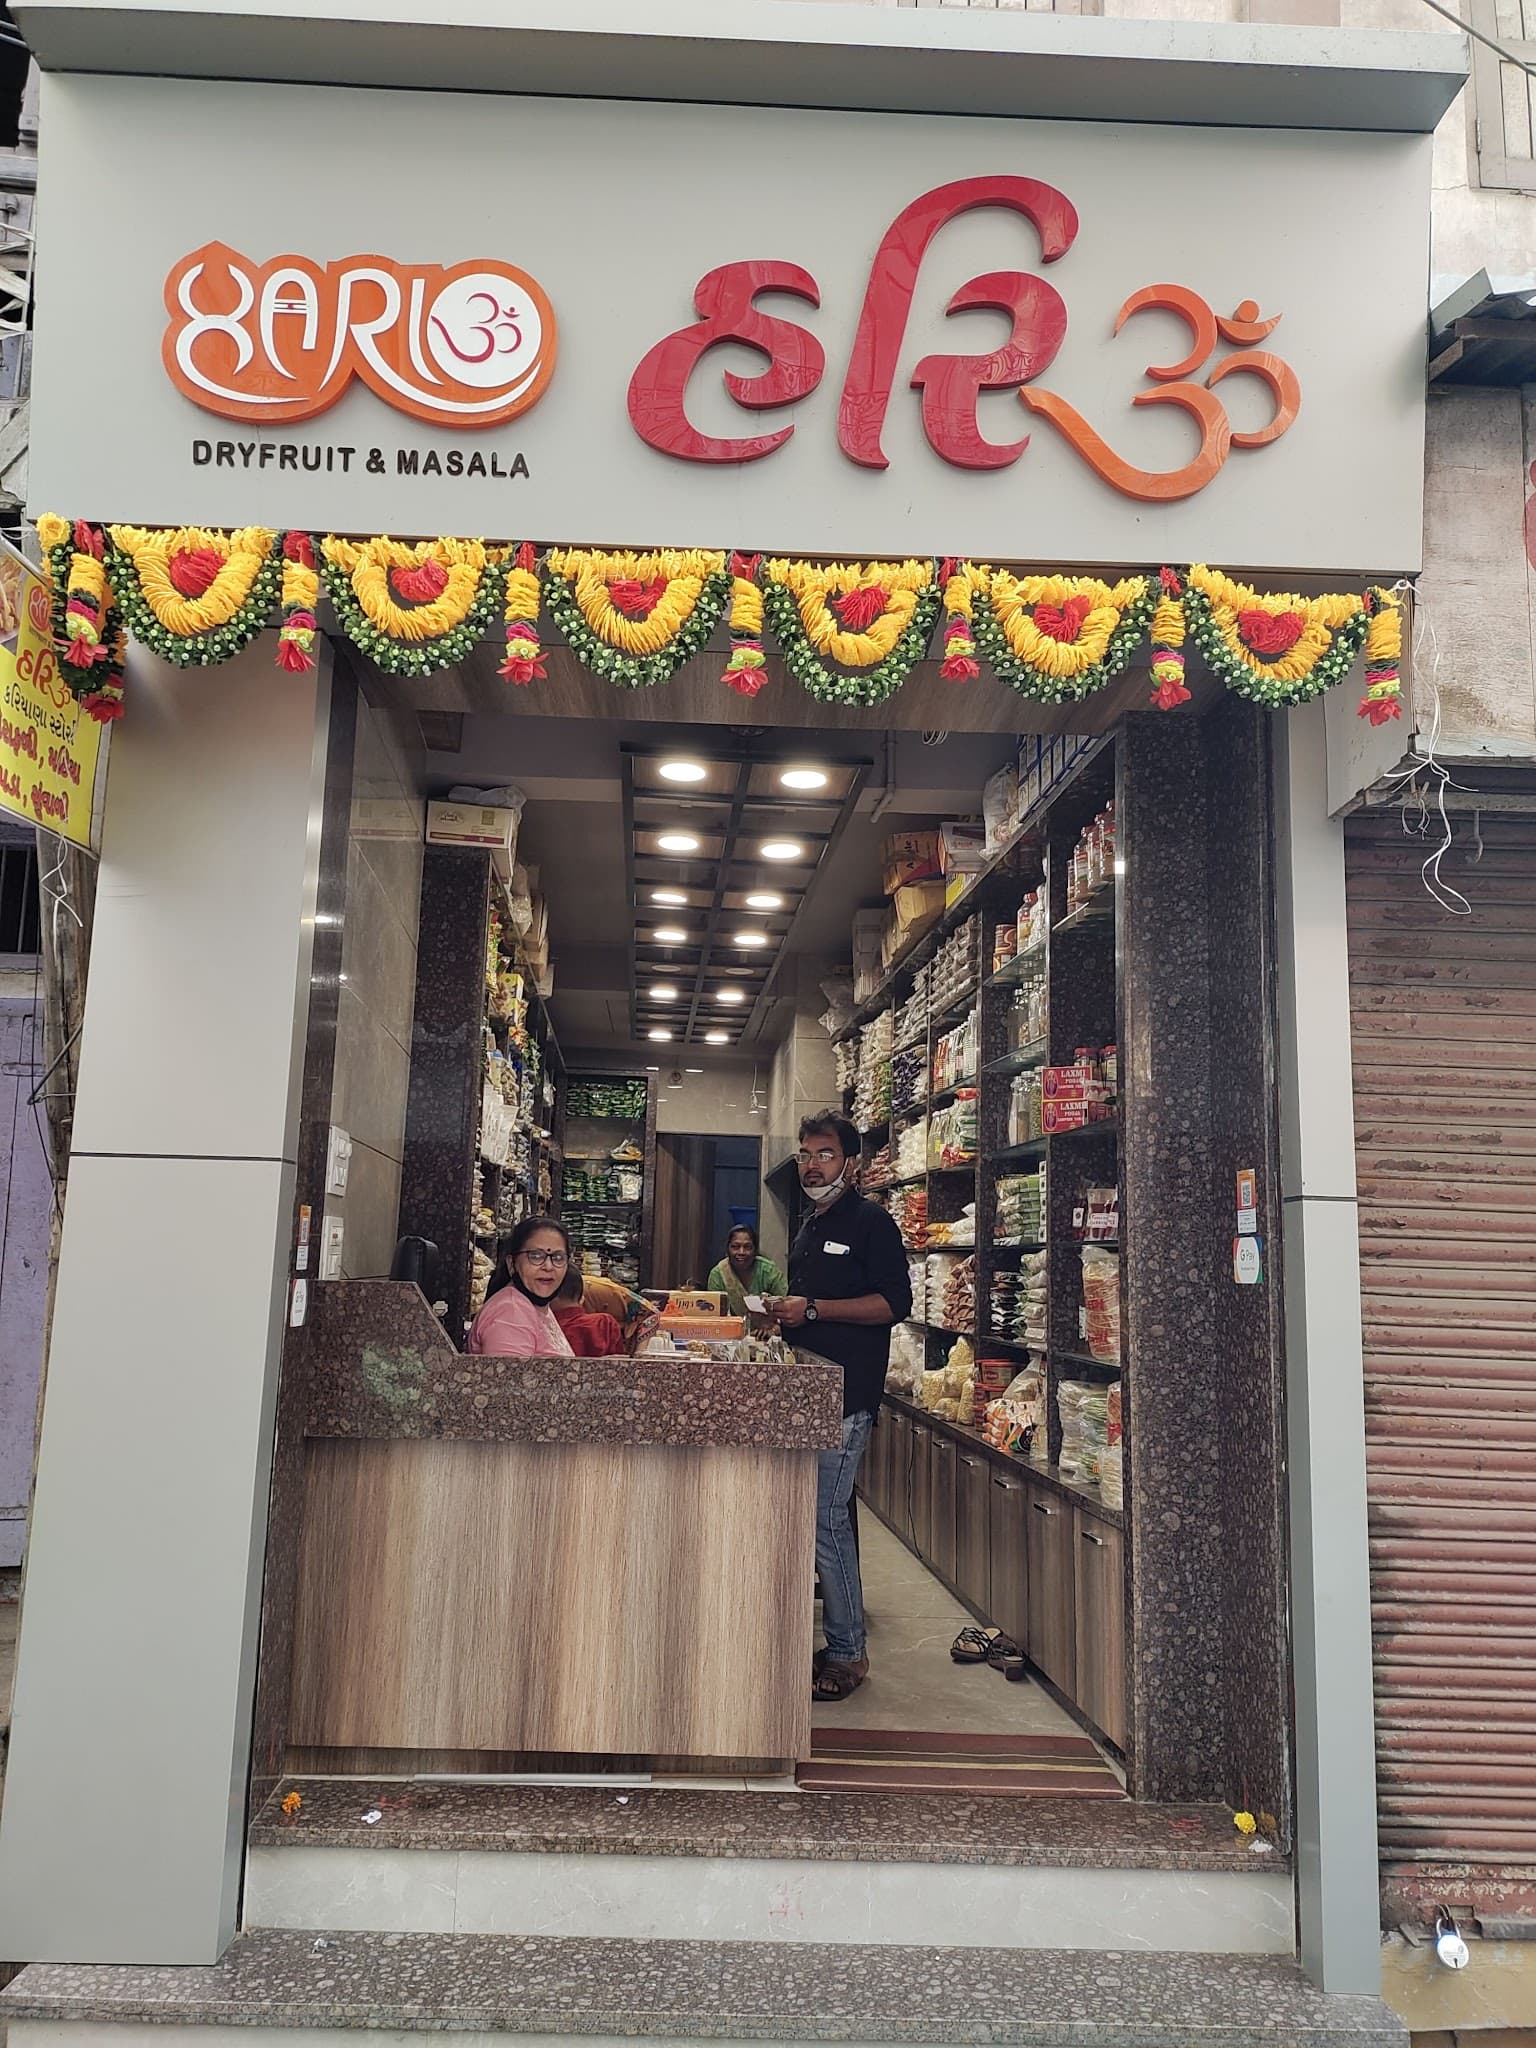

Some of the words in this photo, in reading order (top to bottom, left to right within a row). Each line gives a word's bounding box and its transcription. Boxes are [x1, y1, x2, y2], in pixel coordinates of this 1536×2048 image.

[627, 174, 1079, 471] હરિ
[192, 440, 356, 473] DRYFRUIT
[365, 448, 386, 475] &
[397, 449, 530, 479] MASALA
[1060, 1069, 1086, 1078] LAXMI
